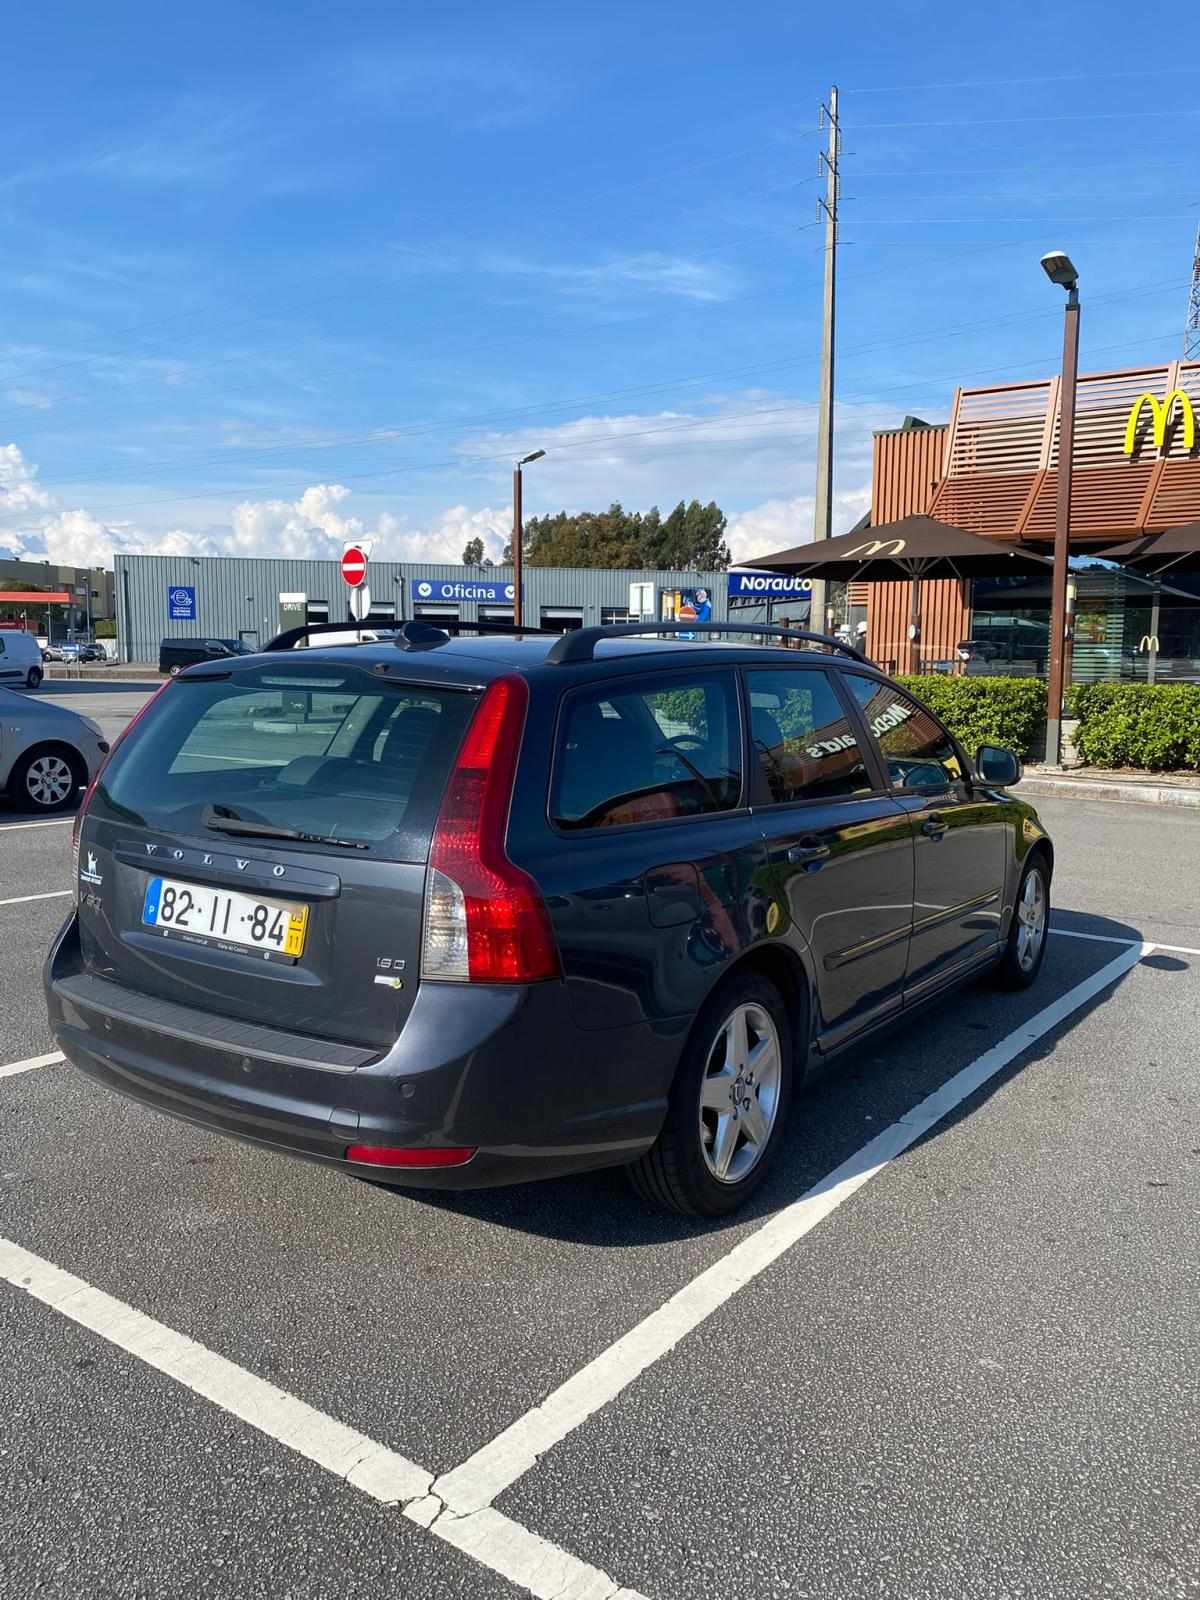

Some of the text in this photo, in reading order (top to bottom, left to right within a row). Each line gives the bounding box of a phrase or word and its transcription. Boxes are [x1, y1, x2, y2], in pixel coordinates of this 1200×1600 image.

[441, 583, 496, 599] Oficina
[740, 575, 813, 591] Norauto
[145, 843, 286, 877] VOLVO
